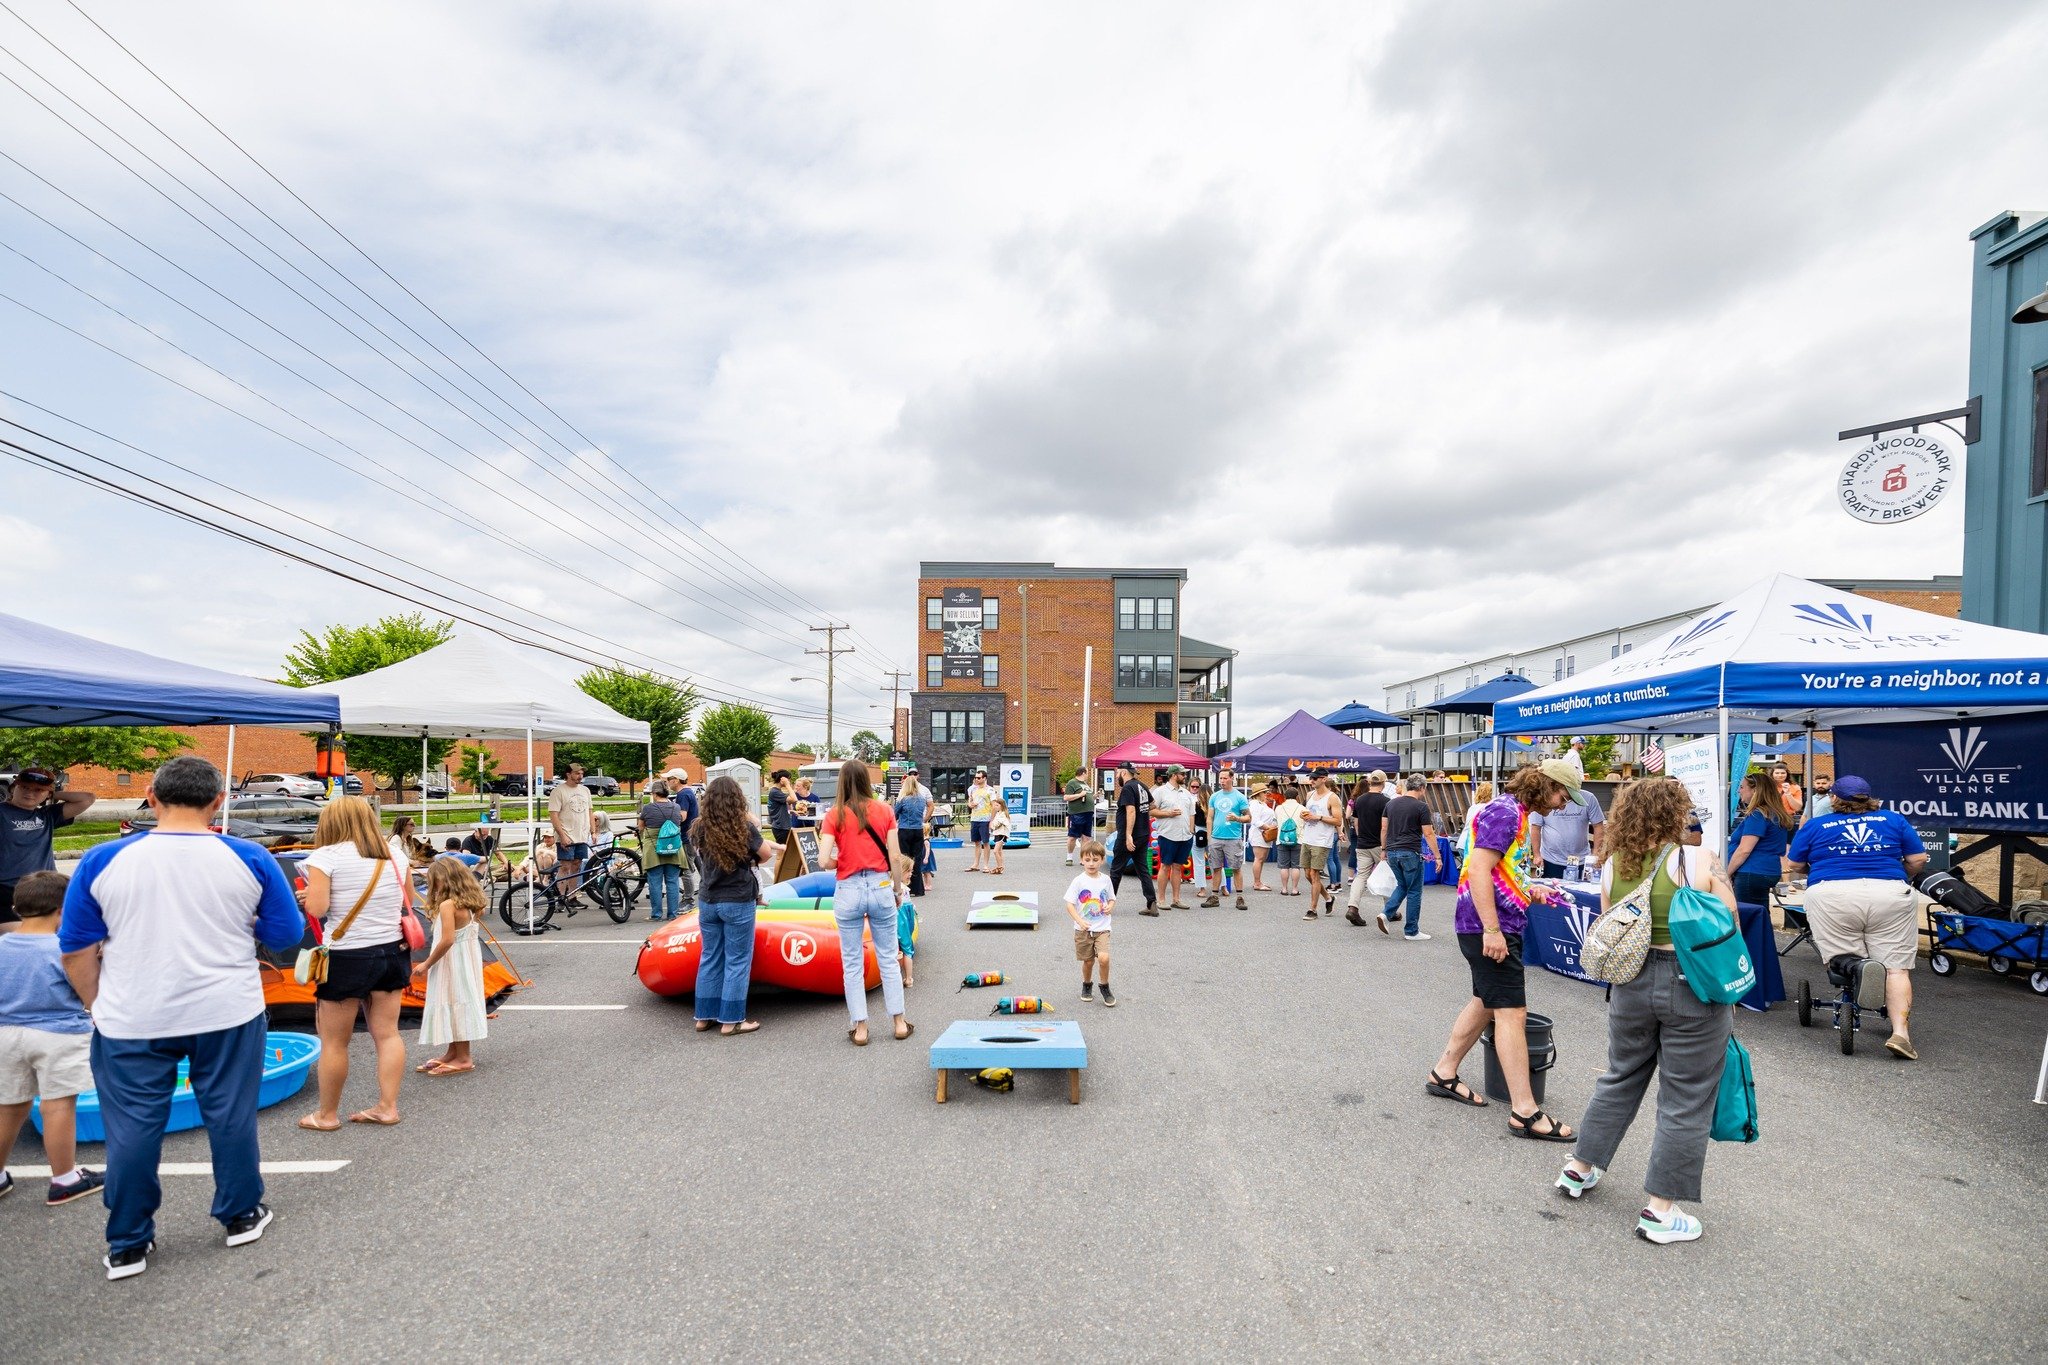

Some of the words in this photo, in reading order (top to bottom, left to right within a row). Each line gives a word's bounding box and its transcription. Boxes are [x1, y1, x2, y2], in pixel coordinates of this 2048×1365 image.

[1842, 437, 1926, 487] HARDYWOOD
[1926, 443, 1952, 474] PARK
[1864, 459, 1879, 474] BREW
[1902, 450, 1930, 464] PURPOSE
[1843, 489, 1879, 518] CRAFT
[1882, 478, 1948, 519] BREWERY
[1900, 484, 1928, 504] VIRGINIA
[946, 610, 958, 618] NOW
[960, 610, 979, 618] SELLING
[1798, 634, 1960, 644] VILLAGE
[1870, 675, 1882, 688] a
[1887, 669, 1982, 691] neighbor,
[1988, 670, 2023, 685] not
[2028, 672, 2041, 685] a
[1544, 704, 1549, 714] a
[1551, 696, 1592, 714] neighbor,
[1594, 692, 1612, 706] not
[1614, 693, 1620, 703] a
[1623, 684, 1670, 702] number.
[1306, 758, 1360, 770] sportable
[1538, 754, 1564, 762] CRAF
[1670, 754, 1691, 764] Thank
[1694, 748, 1710, 758] You
[1672, 762, 1710, 776] Sponsors
[1923, 773, 2010, 784] VILLAGE
[1938, 786, 1994, 794] BANK
[1889, 800, 1958, 817] LOCAL.
[1965, 802, 2029, 819] BANK
[1822, 821, 1838, 829] This
[1724, 976, 1746, 992] BEYOND
